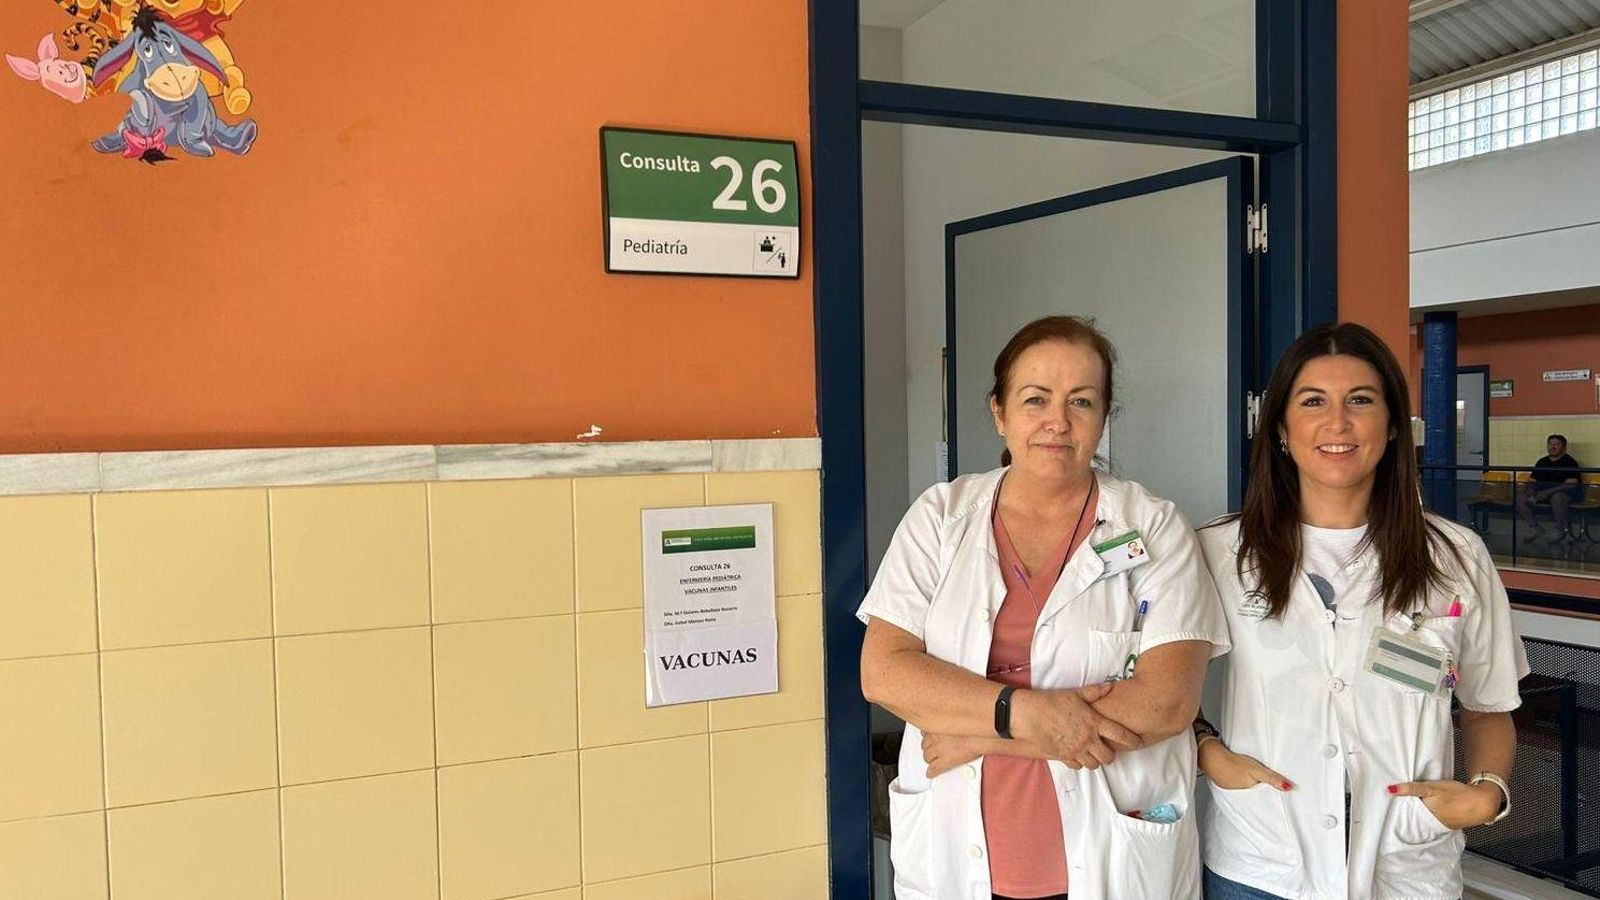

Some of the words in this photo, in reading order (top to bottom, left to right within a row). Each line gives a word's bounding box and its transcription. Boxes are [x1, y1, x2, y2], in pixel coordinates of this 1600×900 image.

[619, 152, 700, 173] Consulta
[710, 156, 787, 214] 26
[623, 238, 688, 255] Pediatría
[689, 563, 722, 572] CONSULTA
[679, 576, 711, 584] ENFERMERÍA
[713, 574, 741, 582] PEDIÁTRICA
[660, 648, 757, 670] VACUNAS
